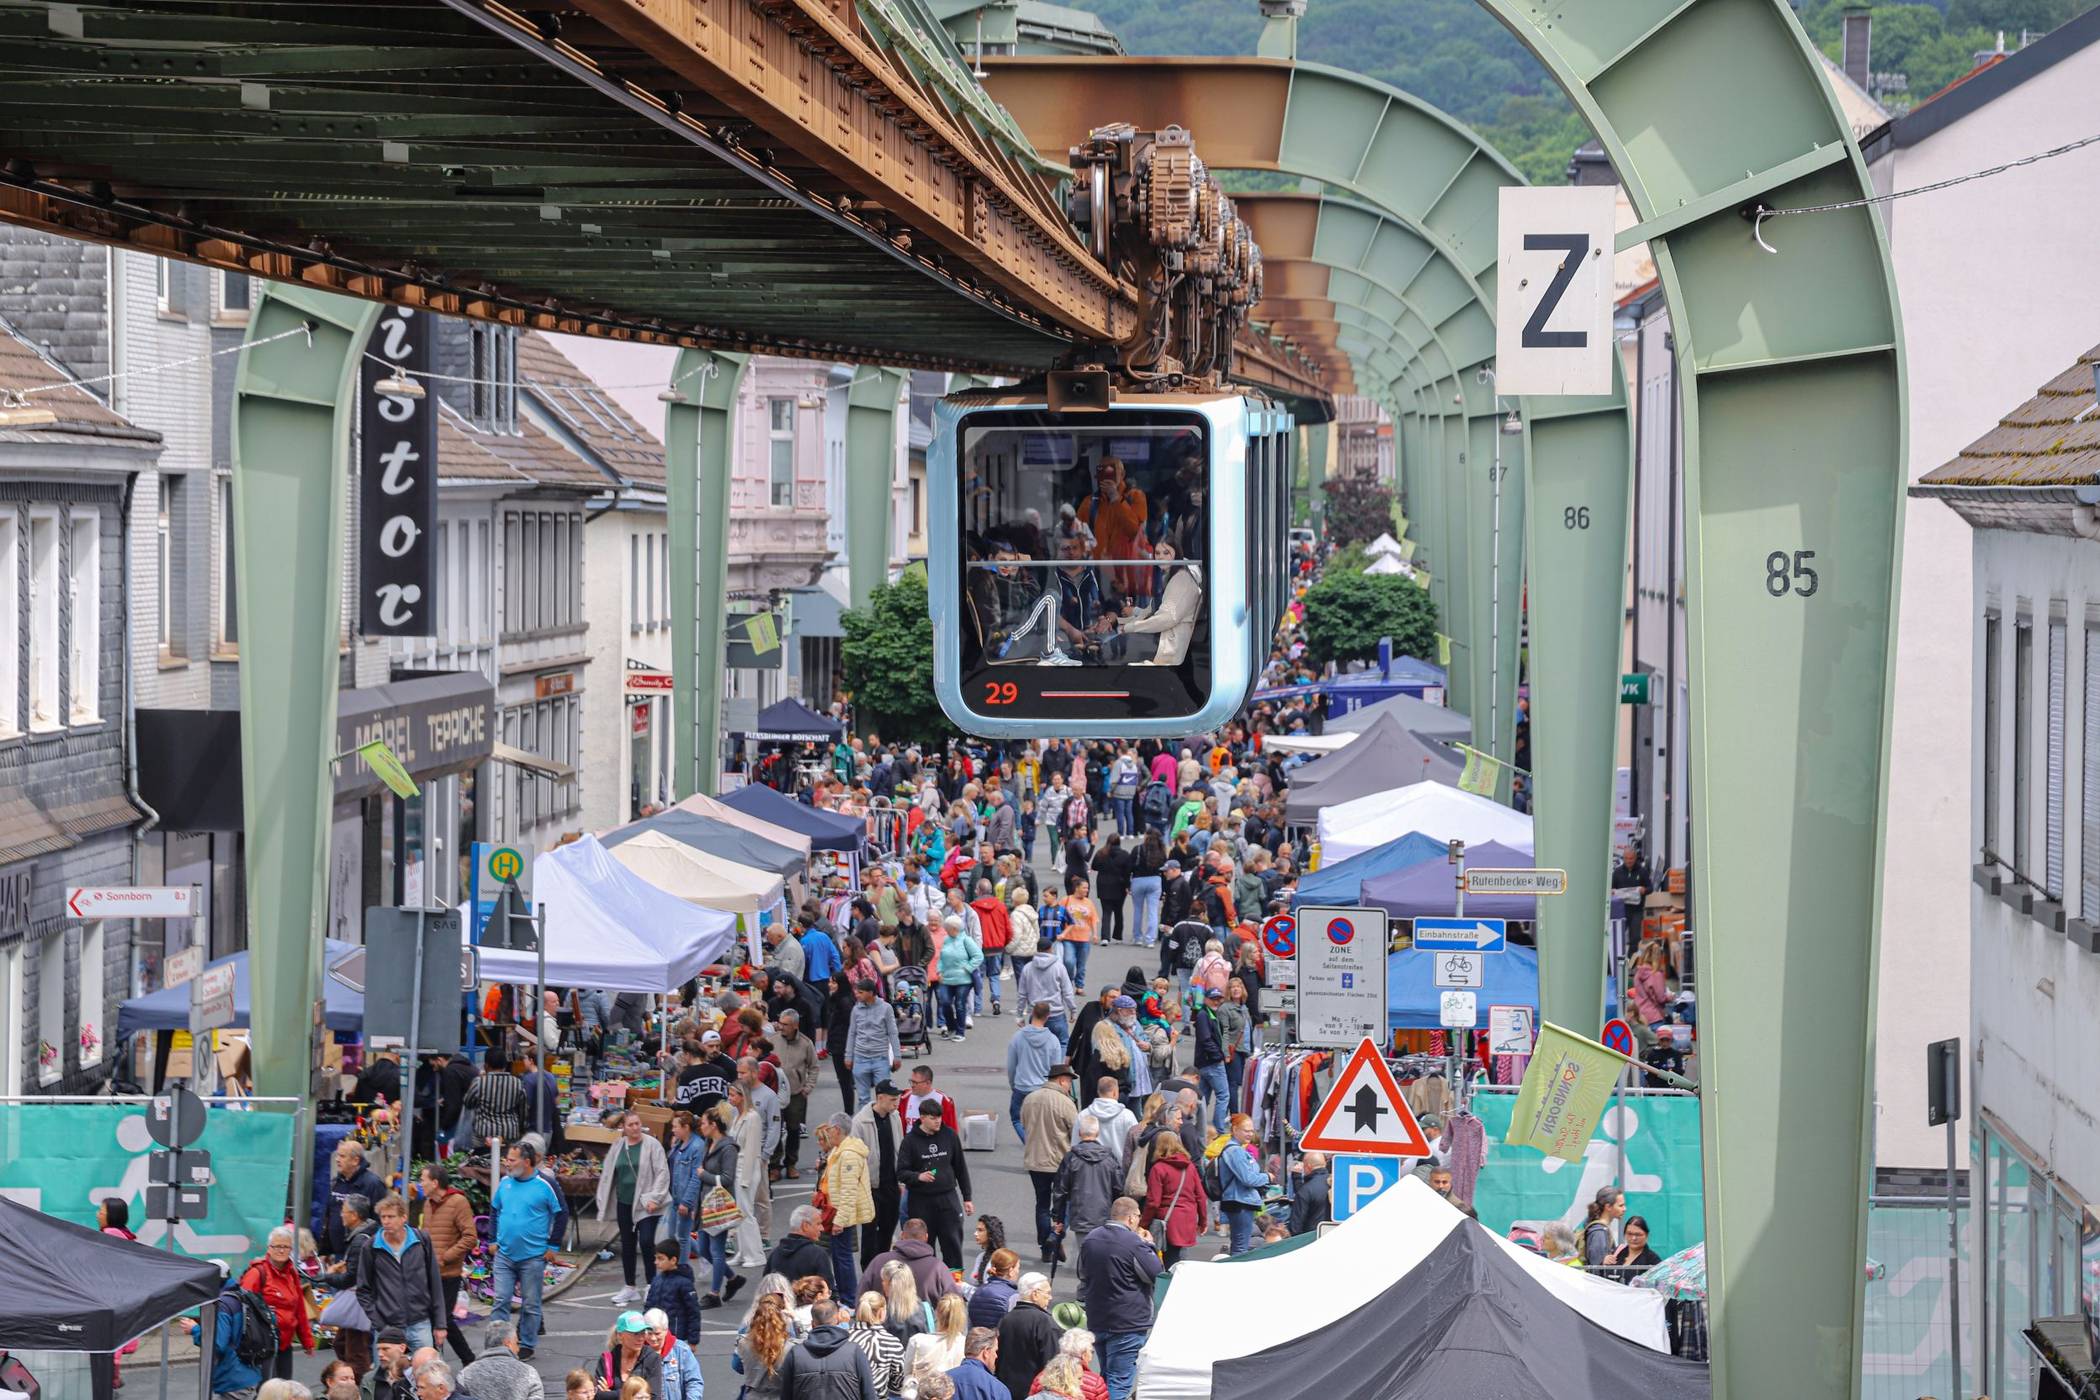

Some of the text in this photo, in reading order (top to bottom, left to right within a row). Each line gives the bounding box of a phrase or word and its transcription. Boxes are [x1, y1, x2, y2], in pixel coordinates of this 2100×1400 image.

[1522, 233, 1589, 347] Z
[1489, 467, 1508, 482] 87
[1564, 506, 1590, 530] 86
[1766, 551, 1819, 597] 85
[985, 682, 1018, 704] 29
[356, 713, 416, 775] MÖBEL
[427, 704, 485, 752] TEPPICHE
[499, 856, 514, 875] H
[1472, 876, 1558, 889] Rutenbecker Weg
[106, 891, 152, 901] Sonnborn
[1419, 929, 1479, 940] Einbahnstraße
[1330, 946, 1352, 954] ZONE
[680, 1078, 727, 1101] AGERF
[1348, 1164, 1384, 1214] P
